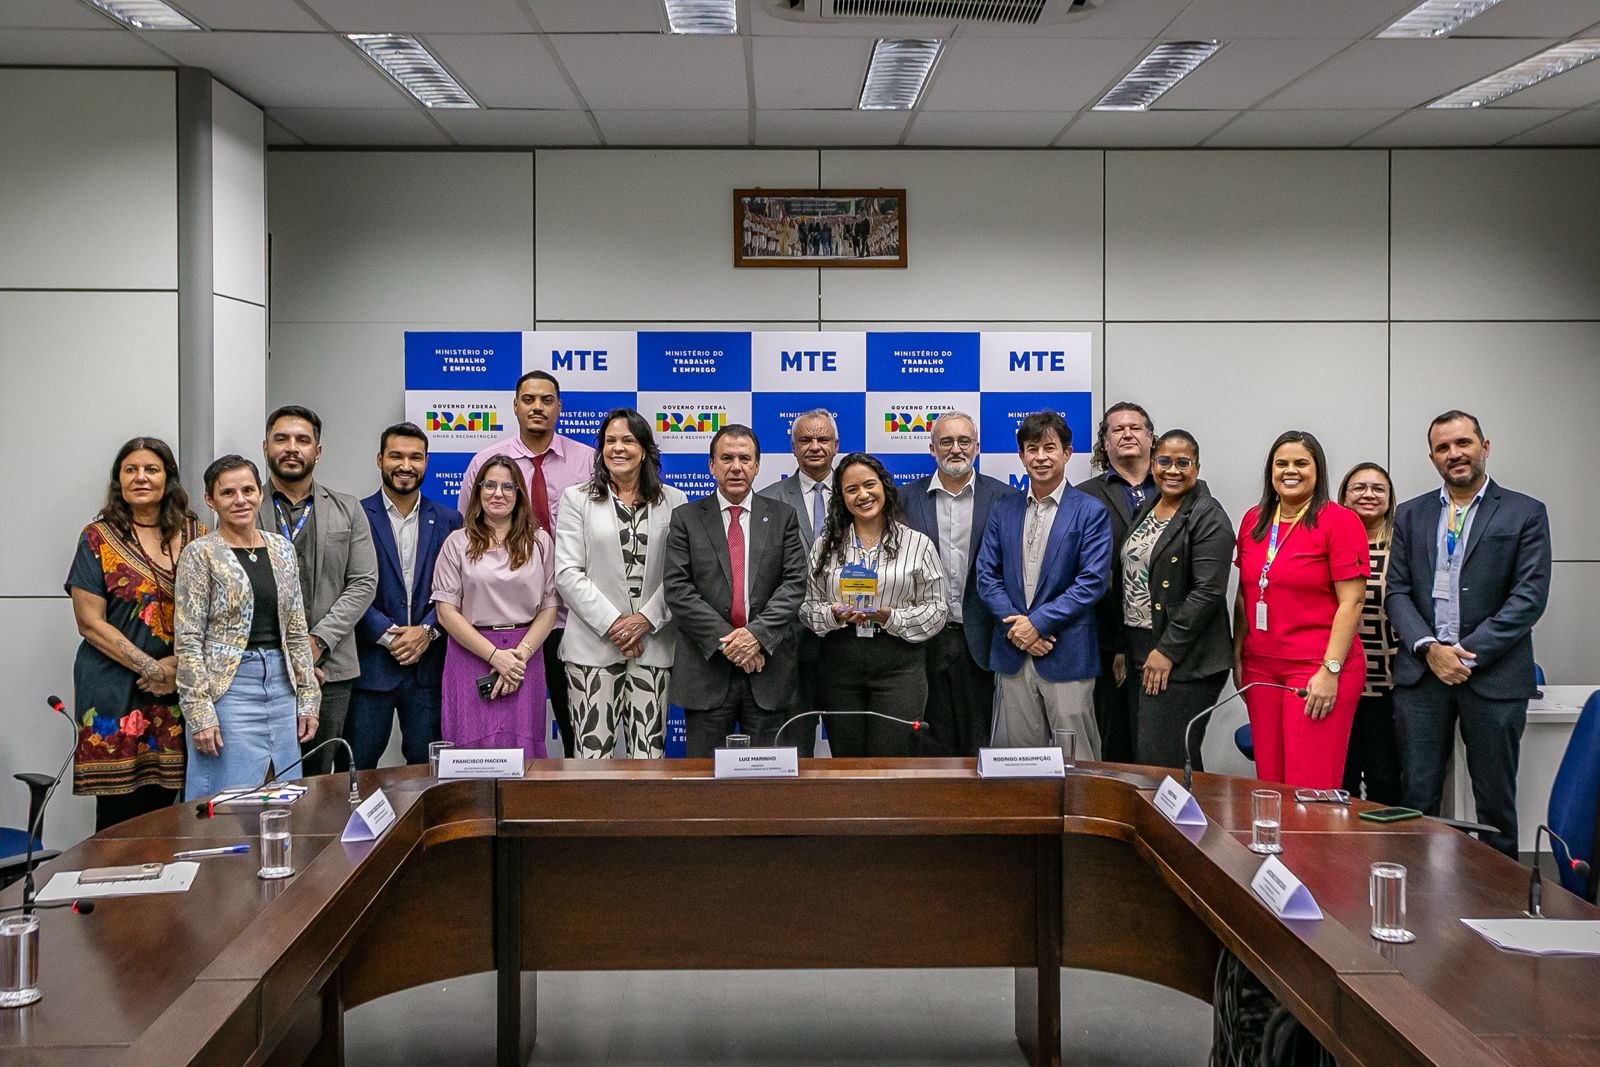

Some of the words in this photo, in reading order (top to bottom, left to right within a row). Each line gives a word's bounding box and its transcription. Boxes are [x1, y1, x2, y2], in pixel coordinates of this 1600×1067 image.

[435, 348, 481, 356] MINISTÉRIO
[665, 349, 710, 357] MINISTÉRIO
[894, 349, 939, 357] MINISTÉRIO
[552, 350, 608, 371] MTE
[781, 351, 837, 372] MTE
[1009, 351, 1065, 372] MTE
[426, 412, 503, 431] BRASIL
[665, 472, 710, 480] MINISTÉRIO
